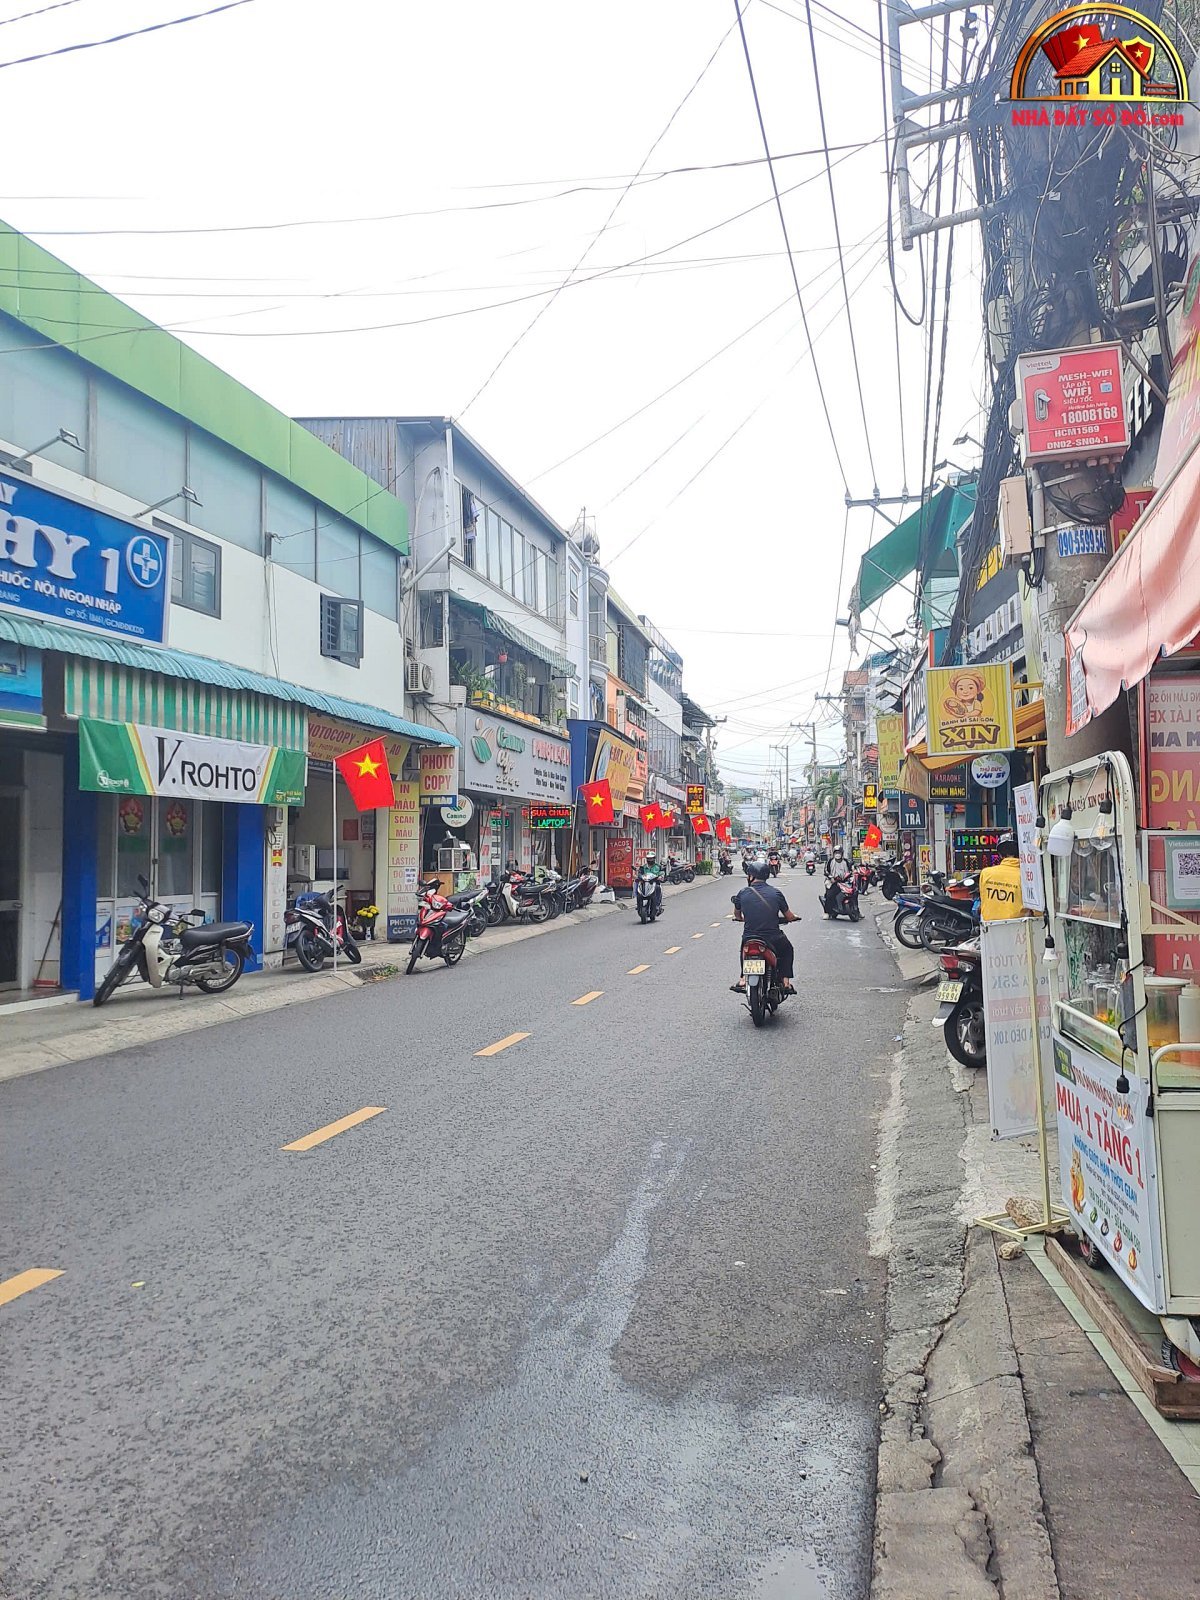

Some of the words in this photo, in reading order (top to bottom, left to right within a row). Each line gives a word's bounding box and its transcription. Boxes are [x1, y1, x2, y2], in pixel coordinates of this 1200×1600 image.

[1026, 360, 1052, 369] viettel
[1058, 369, 1113, 382] MESH-WIFI
[1063, 386, 1092, 398] WIFI
[1061, 406, 1118, 424] 18008168
[101, 548, 119, 594] 1
[59, 586, 94, 608] NGOẠI
[95, 598, 122, 615] NHẬP
[422, 753, 455, 770] PHOTO
[424, 774, 452, 791] COPY
[934, 774, 962, 783] KARAOKE
[399, 783, 410, 794] IN
[931, 785, 949, 796] CHÍNH
[394, 816, 415, 824] SCAN
[537, 819, 566, 827] LAPTOP
[905, 811, 922, 825] TRÀ
[609, 840, 630, 848] TACOS
[986, 887, 1015, 904] TADA
[392, 926, 415, 935] COPY
[1056, 1081, 1084, 1131] MUA
[1085, 1105, 1093, 1141] 1
[1094, 1107, 1134, 1176] TẶNG
[1135, 1147, 1145, 1190] 1
